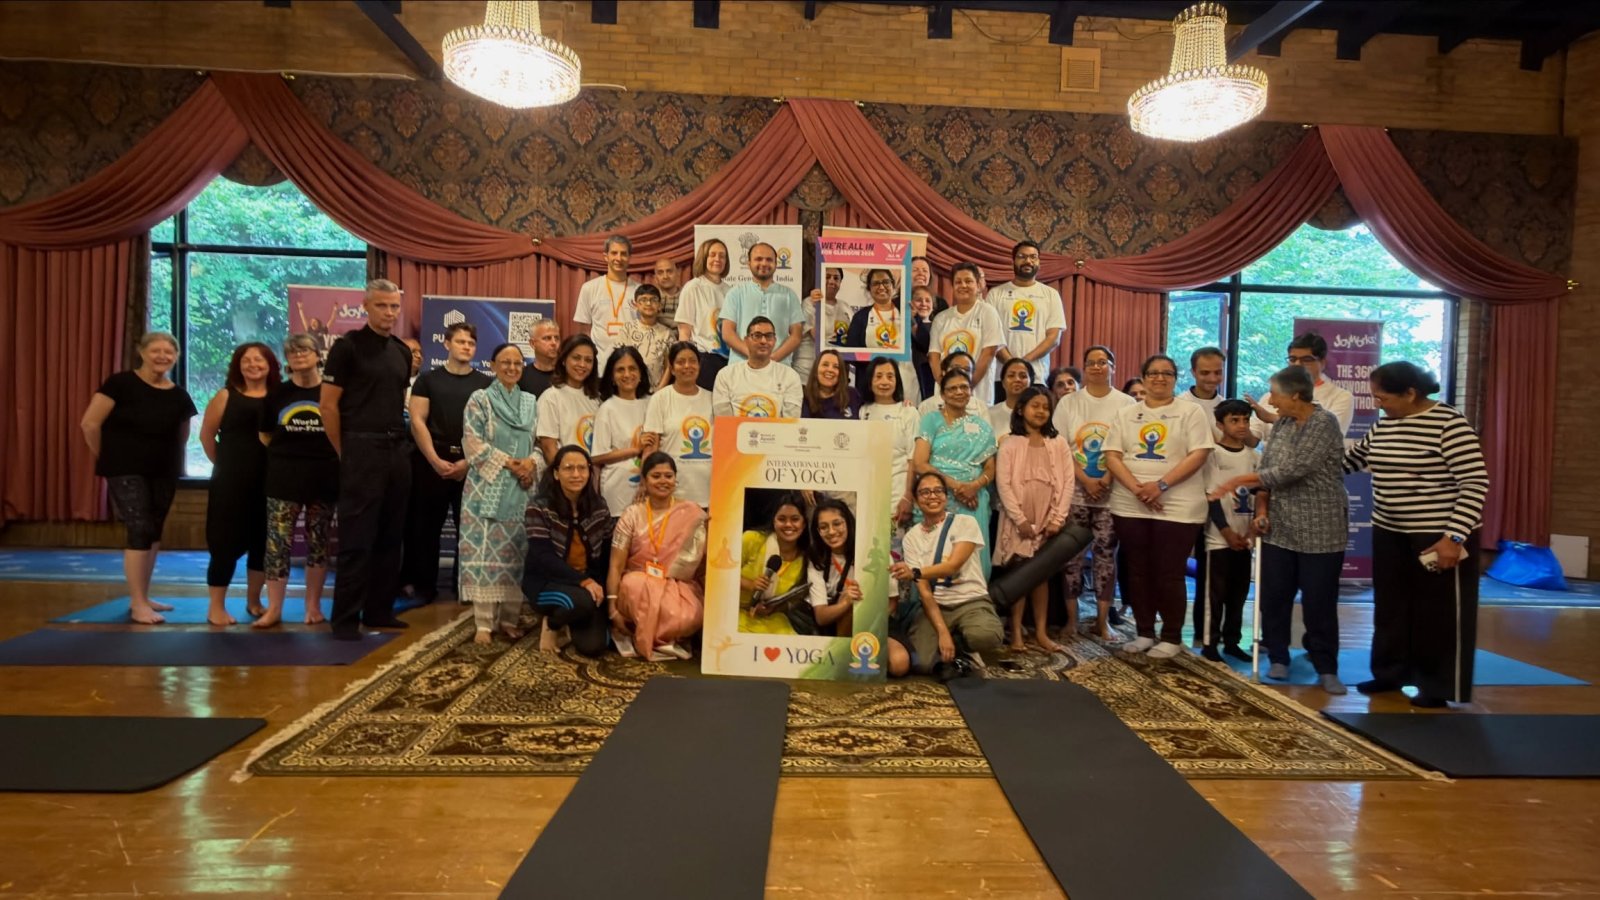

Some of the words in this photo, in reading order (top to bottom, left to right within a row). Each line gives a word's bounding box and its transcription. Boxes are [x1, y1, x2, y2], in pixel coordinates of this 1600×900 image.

[821, 242, 847, 250] WE'RE
[865, 243, 875, 251] IN
[432, 333, 446, 343] PU
[1336, 364, 1353, 378] THE
[292, 418, 319, 426] World
[767, 460, 819, 468] INTERNATIONAL
[822, 461, 836, 469] DAY
[765, 468, 786, 482] OF
[791, 468, 837, 484] YOGA
[753, 646, 758, 662] I
[786, 647, 835, 666] YOGA
